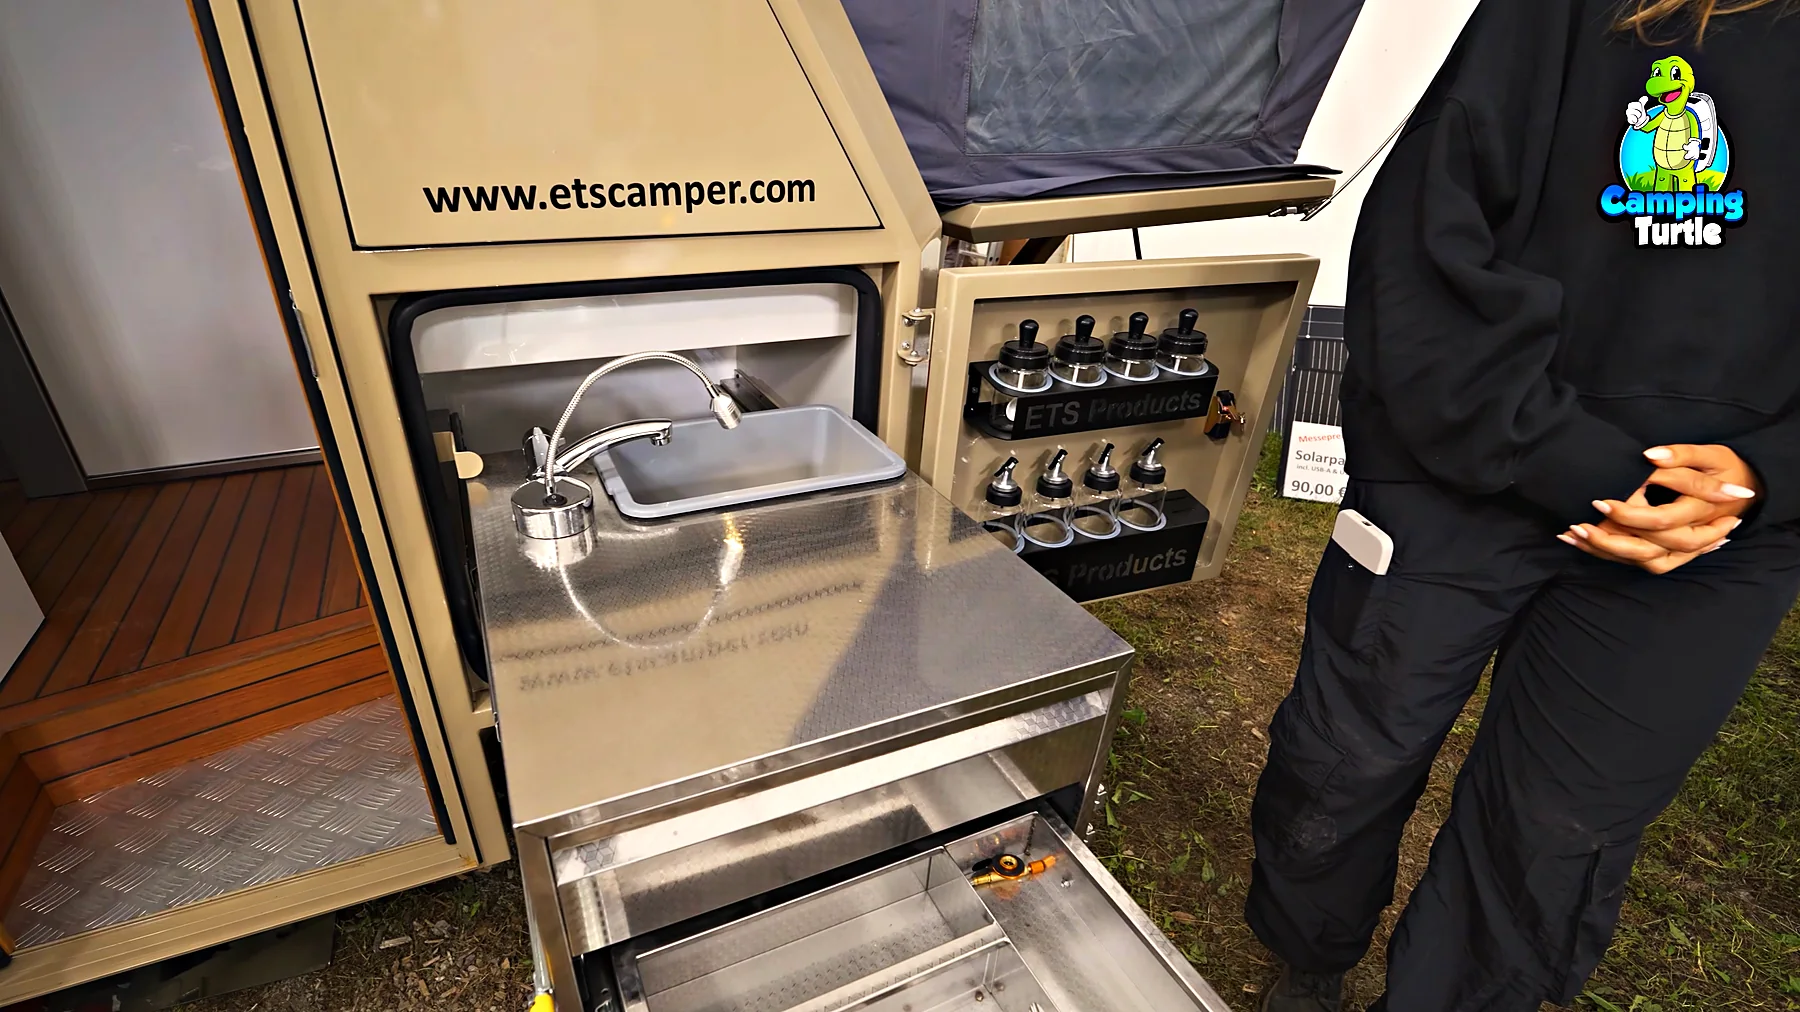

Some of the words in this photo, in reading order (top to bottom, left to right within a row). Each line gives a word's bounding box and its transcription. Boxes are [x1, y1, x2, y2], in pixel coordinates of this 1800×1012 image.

[422, 178, 816, 214] www.etscamper.com
[1024, 401, 1080, 432] ETS
[1088, 389, 1203, 424] Products
[1298, 433, 1342, 443] Messepre
[1291, 480, 1334, 496] 90,00
[1338, 486, 1347, 498] €
[1067, 547, 1188, 587] Products
